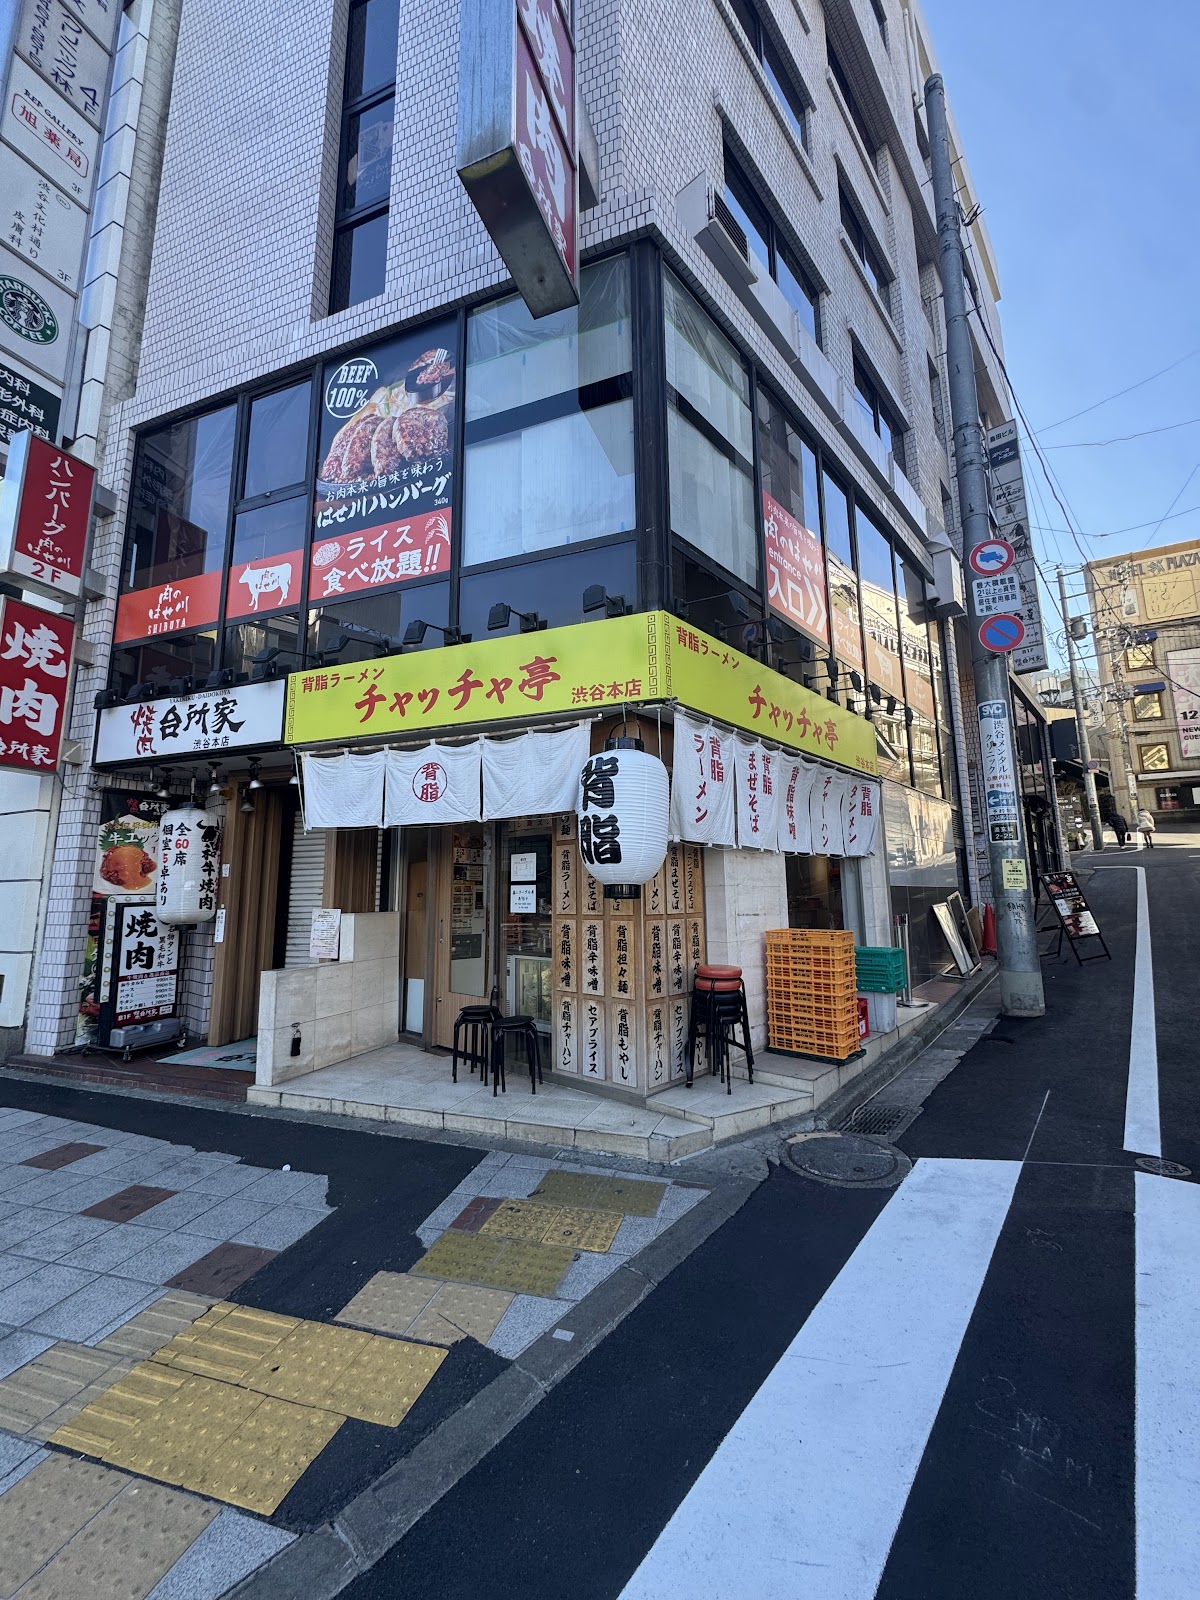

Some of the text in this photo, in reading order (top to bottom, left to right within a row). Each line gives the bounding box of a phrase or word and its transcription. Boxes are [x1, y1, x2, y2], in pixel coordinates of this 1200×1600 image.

[24, 88, 85, 147] REP GALLERY
[80, 86, 100, 116] 4F
[19, 105, 82, 169] 旭薬局
[71, 182, 84, 195] 3F
[8, 210, 27, 249] 皮膚科
[29, 179, 52, 259] 渋谷文化村通り
[57, 269, 72, 283] 3F
[329, 387, 370, 408] 100%
[337, 365, 375, 384] BEEF
[42, 456, 74, 535] ハンバーグ
[316, 471, 453, 529] はせ川ハンバーグ
[325, 457, 445, 503] お肉本来の旨味を味わう
[322, 543, 441, 597] 食べ放題!!
[346, 525, 414, 560] ライス
[768, 537, 802, 581] entrance
[31, 561, 62, 584] 2F
[159, 584, 182, 604] 肉の
[768, 563, 805, 621] 入口
[1109, 563, 1146, 581] HEL
[147, 617, 187, 635] SHIBUYA
[148, 596, 190, 621] はせ川
[676, 625, 740, 670] 背脂ラーメン
[1, 621, 67, 737] 焼肉
[301, 667, 385, 694] 背脂ラーメン
[354, 656, 562, 723] チャッチャ亭
[571, 679, 643, 704] 渋谷本店
[159, 697, 247, 741] 台所家
[748, 684, 839, 752] チャッチャ亭
[982, 704, 1003, 716] SMC
[1180, 710, 1199, 721] 12
[193, 735, 230, 750] 渋谷本店
[709, 735, 724, 783] 背脂
[985, 733, 996, 775] クリニック
[994, 720, 1008, 774] 渋谷メンタル
[420, 762, 441, 802] 背脂
[693, 733, 708, 824] ラーメン
[747, 750, 760, 833] まぜそば
[761, 753, 773, 796] 背脂
[785, 765, 800, 840] 背脂味噌
[860, 786, 873, 817] 背脂
[580, 756, 622, 865] 背脂
[821, 776, 833, 848] チャーハン
[848, 785, 859, 844] タンメン
[160, 823, 174, 906] 個室5卓あり
[173, 822, 192, 866] 全60席
[198, 845, 217, 911] 和牛焼肉
[561, 849, 571, 911] 背脂ラーメン
[670, 846, 680, 910] 背脂まぜそば
[125, 910, 158, 970] 焼肉
[560, 923, 572, 988] 背脂味噌
[586, 924, 599, 991] 背脂辛味噌
[616, 924, 629, 994] 背脂担々麺
[651, 925, 662, 994] 背脂味噌
[671, 923, 683, 990] 背脂辛味噌
[118, 1013, 132, 1021] B1F
[561, 1000, 572, 1066] 背脂チャーハン
[588, 1004, 598, 1074] セアブライス
[617, 1007, 630, 1080] 背脂もやし
[653, 1008, 663, 1081] 背脂チャーハン
[674, 1004, 684, 1074] セアブライス
